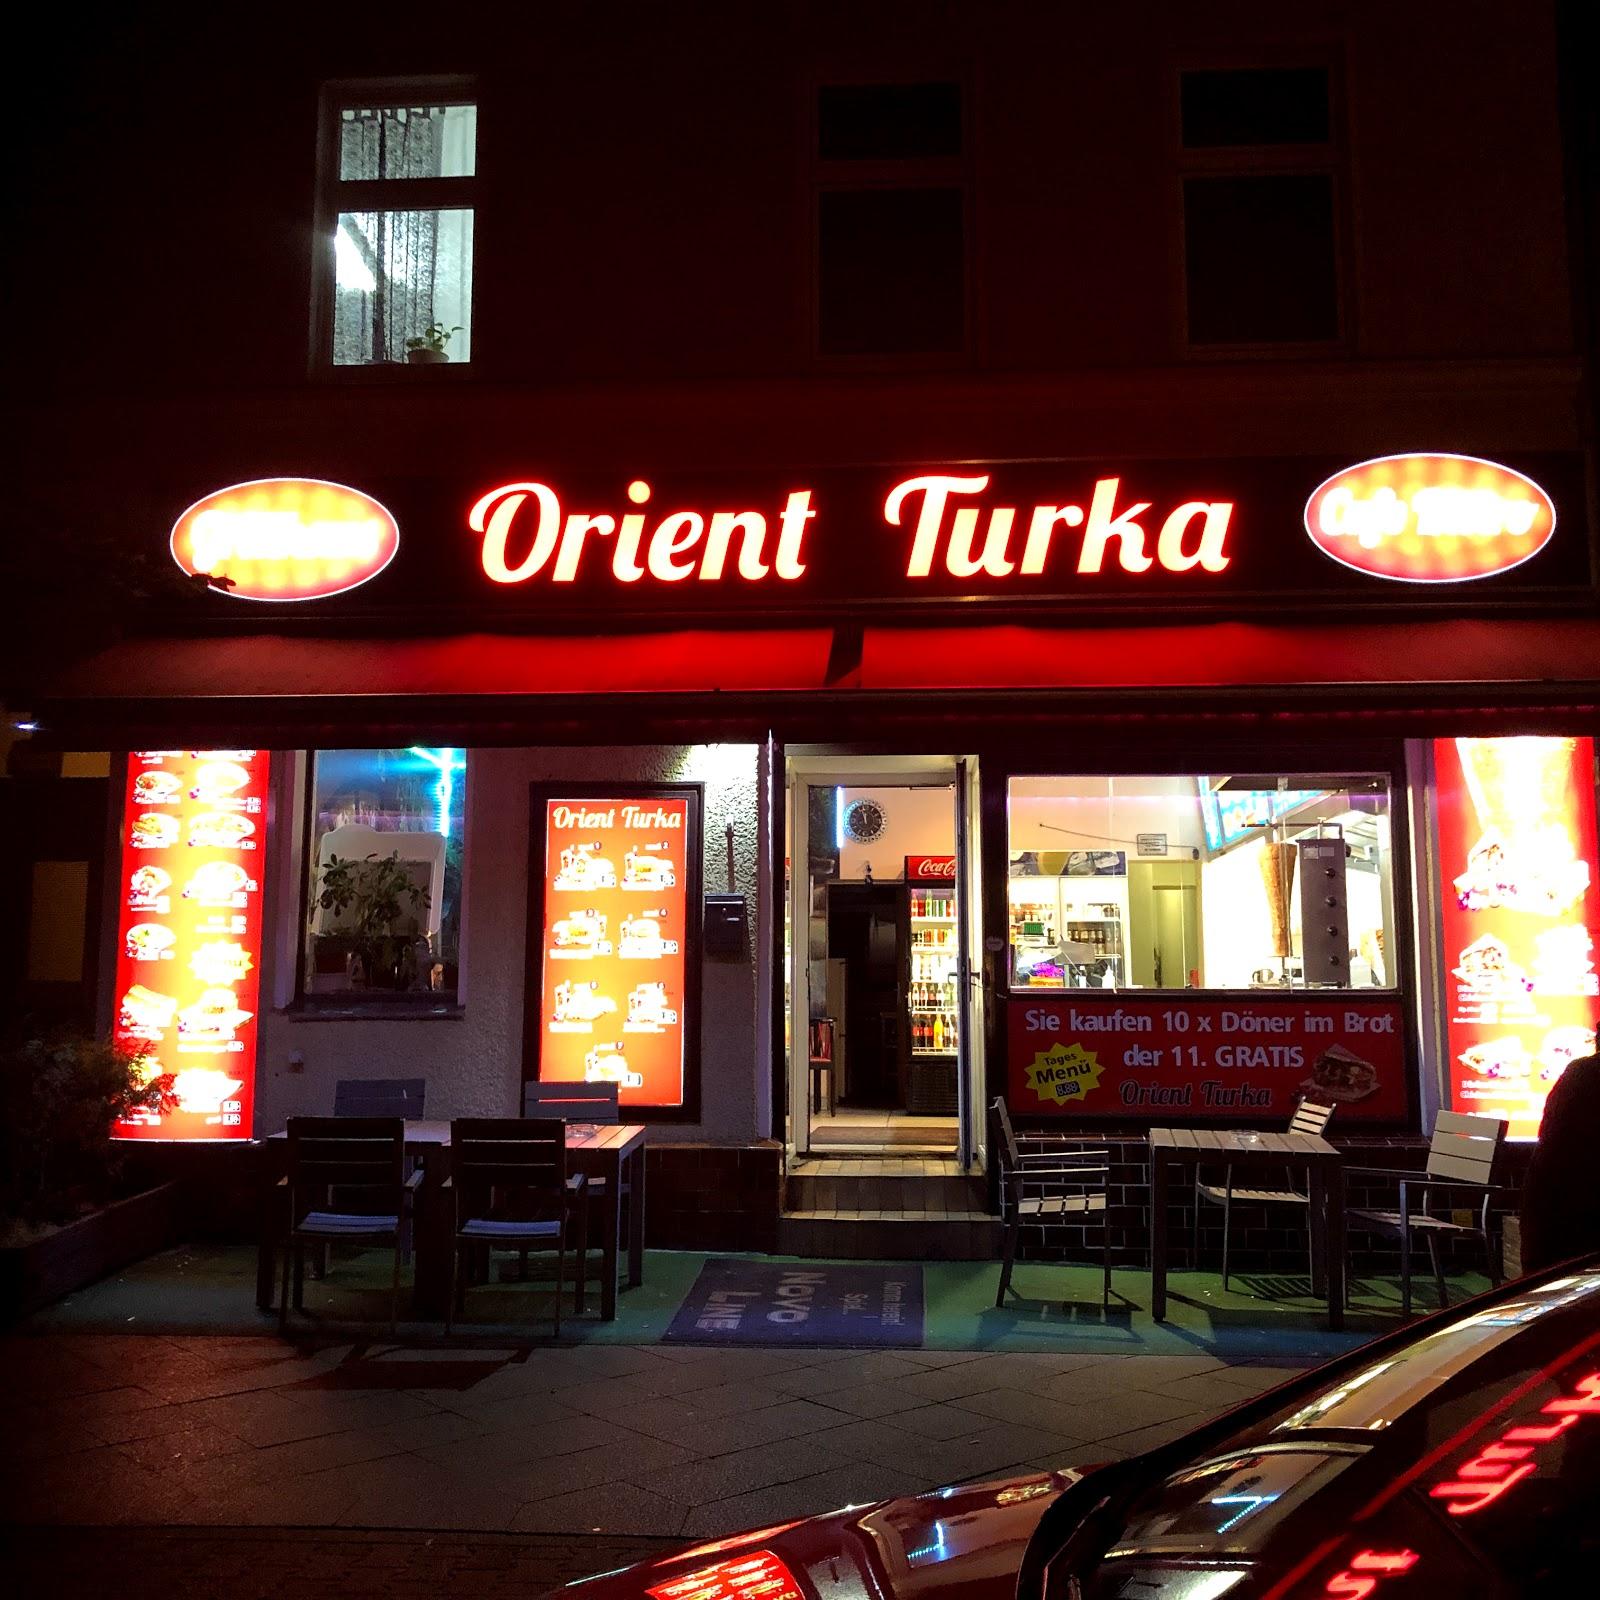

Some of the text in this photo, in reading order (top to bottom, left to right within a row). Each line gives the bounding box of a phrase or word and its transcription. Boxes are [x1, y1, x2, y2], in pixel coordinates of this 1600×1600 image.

[468, 480, 817, 584] Orient
[883, 475, 1234, 578] Turka
[552, 806, 682, 829] Orient Turka
[1025, 1009, 1394, 1033] Sie kaufen 10 x Döner im Brot
[1045, 1052, 1078, 1066] Tages
[1123, 1044, 1304, 1068] der 11. GRATIS
[1036, 1060, 1091, 1084] Menü
[1119, 1078, 1272, 1107] Orient Turka
